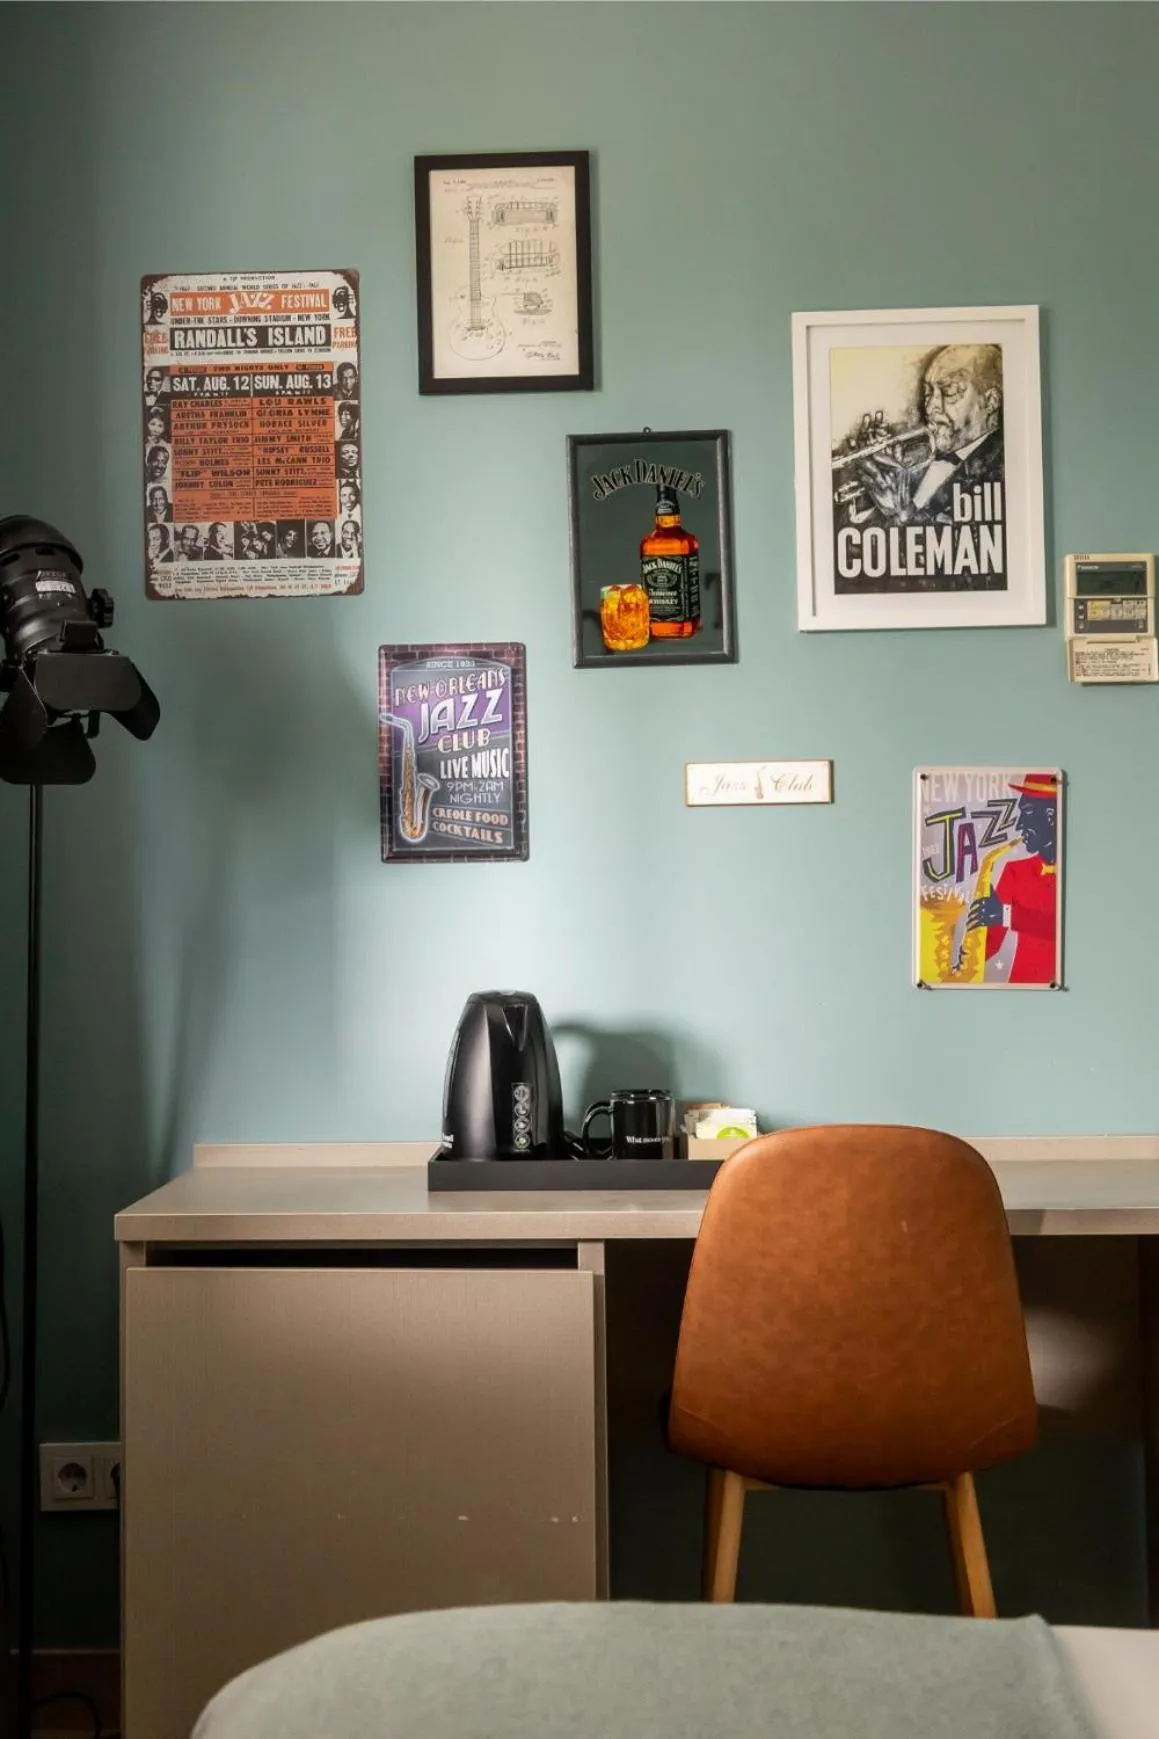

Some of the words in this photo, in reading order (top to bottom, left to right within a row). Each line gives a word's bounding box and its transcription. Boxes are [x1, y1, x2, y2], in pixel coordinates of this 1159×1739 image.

[171, 297, 194, 312] NEW
[196, 296, 222, 311] YORK
[228, 291, 276, 315] JAZZ
[281, 293, 328, 309] FESTIVAL
[207, 315, 228, 324] STARS
[264, 314, 292, 322] STADIUM
[174, 327, 258, 349] RANDALL'S
[267, 325, 327, 347] ISLAND
[333, 326, 356, 338] FREE
[172, 377, 200, 392] SAT.
[203, 376, 231, 391] AUG.
[233, 375, 250, 391] 12
[254, 374, 283, 390] SUN.
[286, 373, 313, 389] AUG.
[316, 373, 331, 389] 13
[172, 400, 190, 408] RAY
[190, 400, 223, 408] CHARLES
[259, 398, 281, 406] LOU
[287, 397, 327, 405] RAWLS
[176, 411, 206, 419] ARETHA
[209, 410, 247, 418] FRANKLIN
[256, 409, 294, 417] GLORIA
[297, 408, 330, 416] LYNNE
[173, 422, 207, 430] ARTHUR
[210, 421, 249, 429] PRYSOCK
[298, 419, 328, 427] SILVER
[173, 436, 196, 445] BILLY
[199, 436, 228, 444] TAYLOR
[231, 436, 250, 444] TRIO
[254, 435, 281, 443] JIMMY
[173, 448, 199, 456] SONNY
[199, 458, 229, 466] HOLMES
[257, 457, 271, 465] LES
[312, 456, 331, 464] TRIO
[211, 469, 251, 477] WILSON
[255, 468, 281, 476] SONNY
[175, 481, 205, 489] JOHNNY
[208, 480, 234, 488] COLON
[255, 479, 273, 487] PETE
[592, 461, 632, 501] JACK
[634, 457, 705, 499] DANIEL'S
[953, 481, 1002, 522] bill
[837, 523, 1003, 579] COLEMAN
[395, 683, 430, 707] NEW
[435, 668, 505, 698] ORLEANS
[418, 688, 503, 745] JAZZ
[437, 728, 491, 753] CLUB
[440, 755, 470, 779] LIVE
[471, 747, 510, 779] MUSIC
[770, 772, 814, 793] Club
[920, 772, 959, 803] NEW
[964, 772, 1013, 802] YORK
[450, 792, 501, 804] NIGHTLY
[432, 807, 472, 821] CREOLE
[475, 813, 508, 826] FOOD
[432, 821, 504, 844] COCKTAILS
[921, 799, 1019, 884] JAZZ
